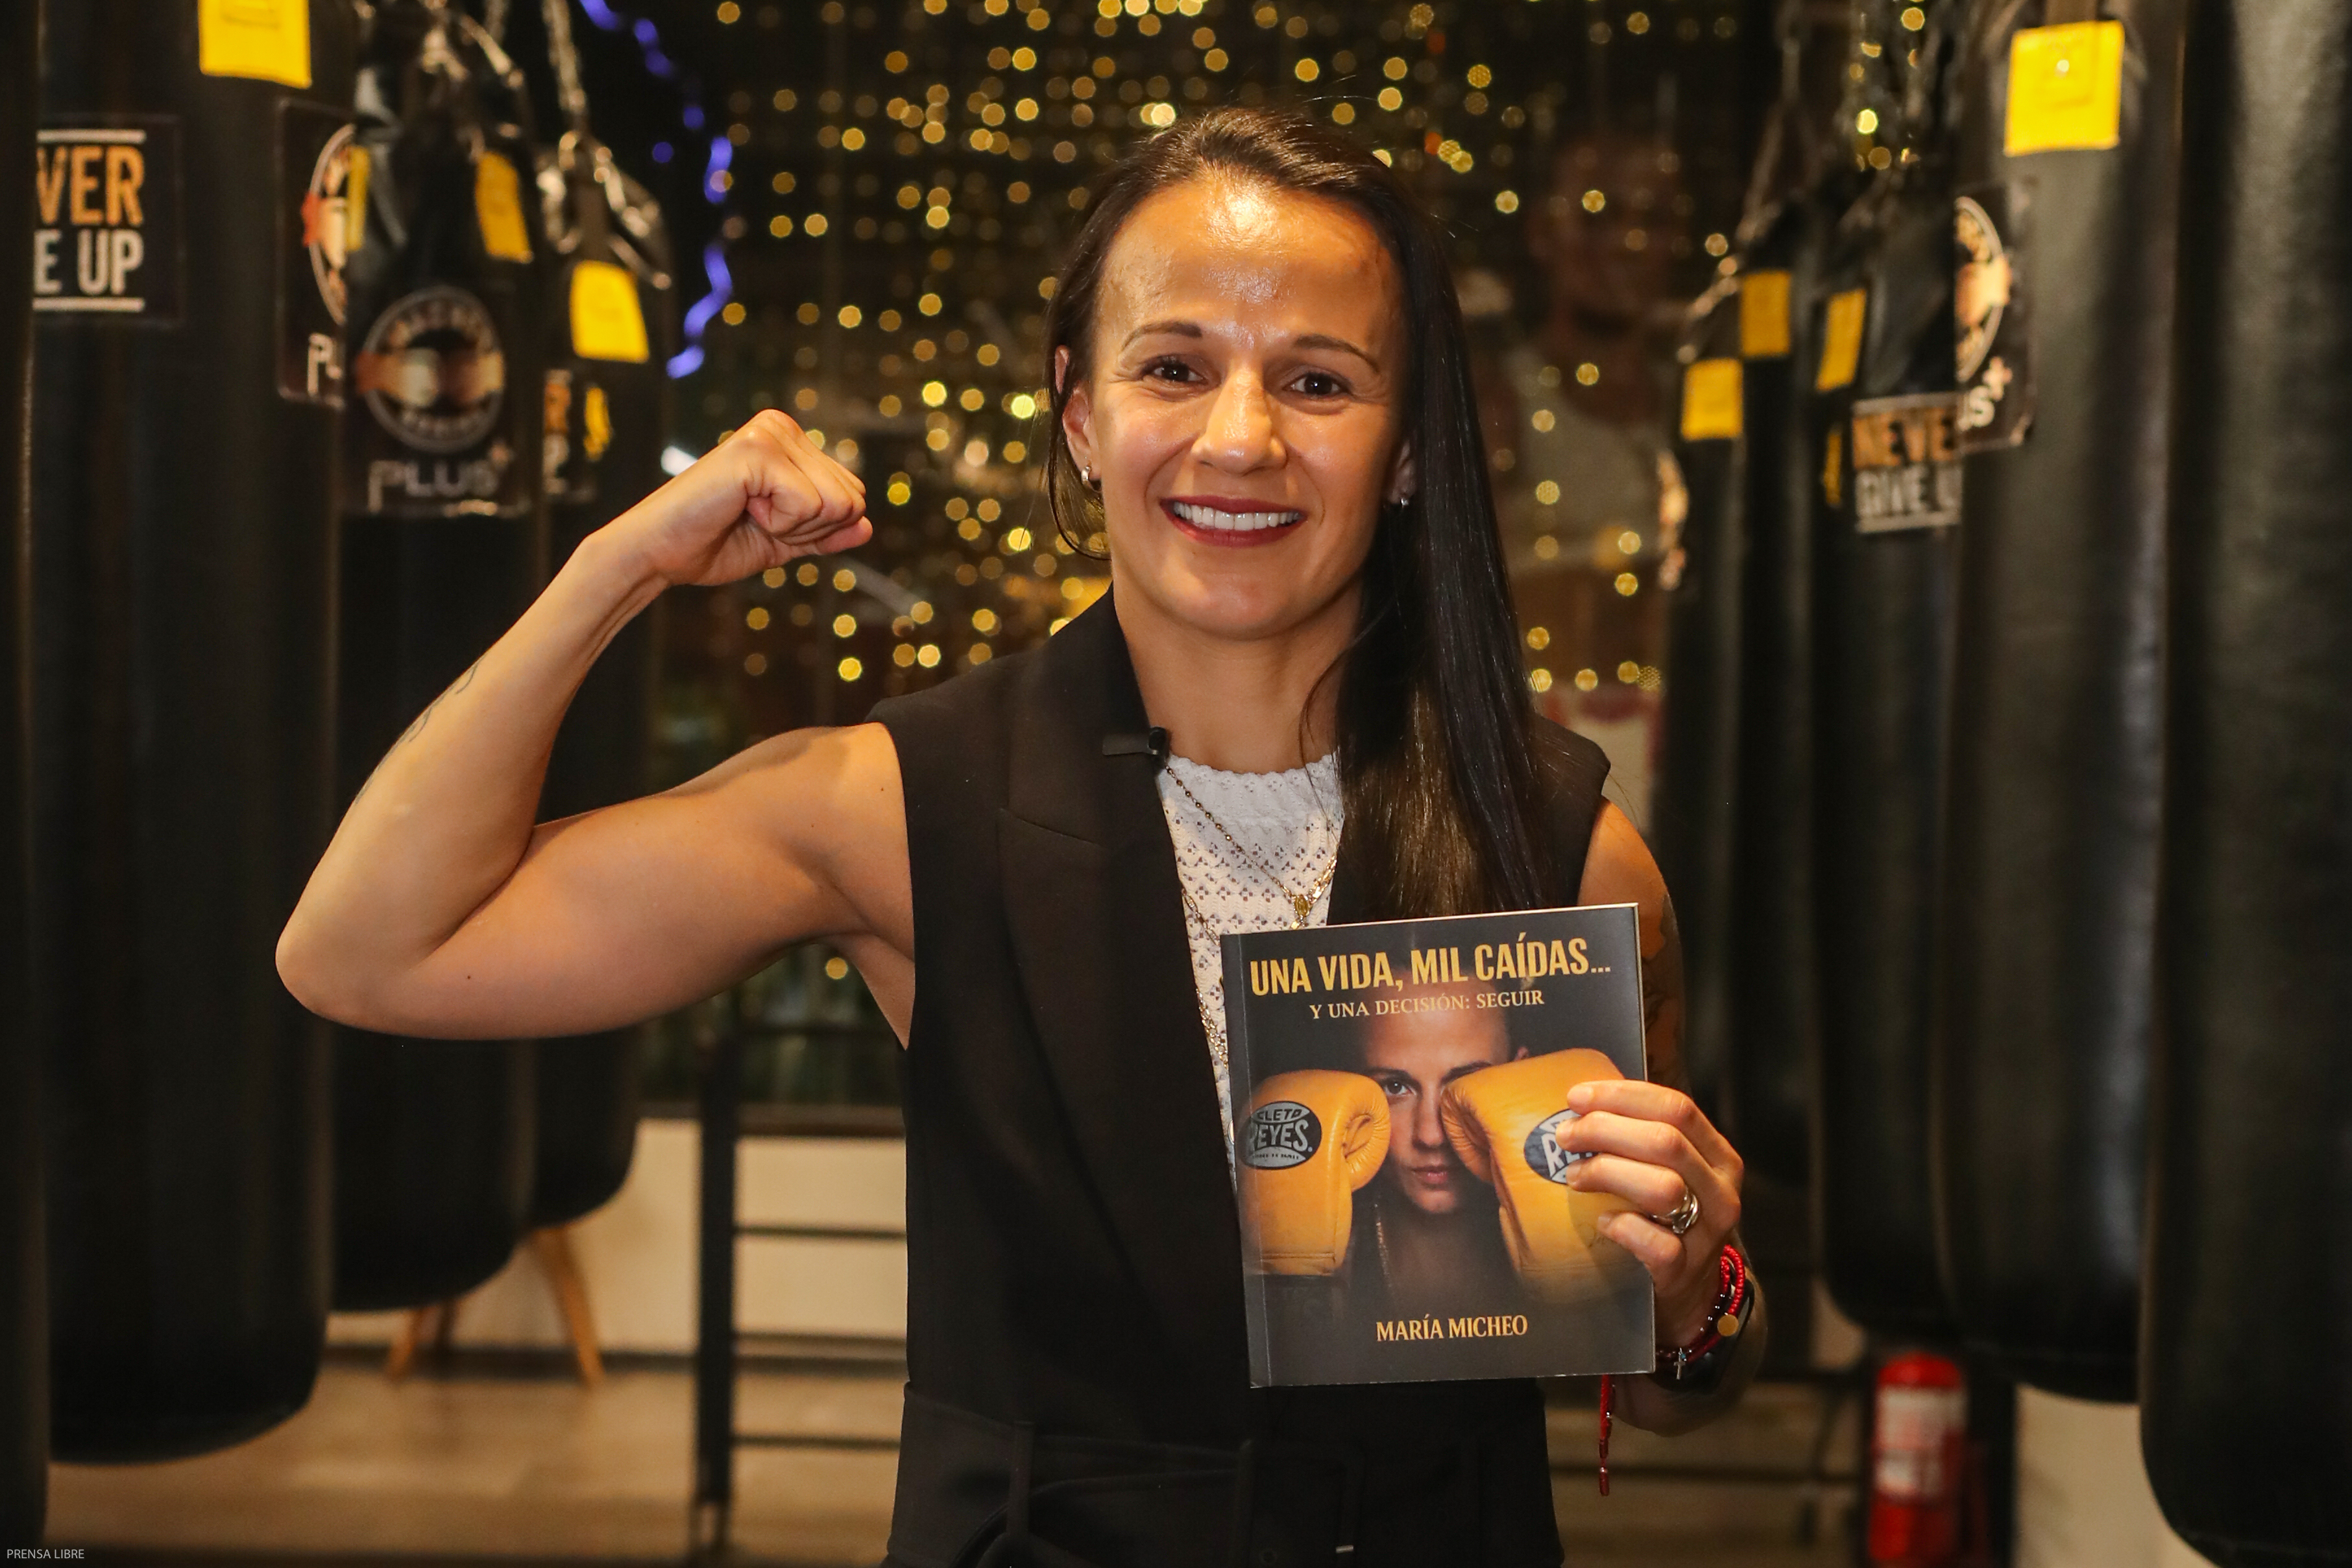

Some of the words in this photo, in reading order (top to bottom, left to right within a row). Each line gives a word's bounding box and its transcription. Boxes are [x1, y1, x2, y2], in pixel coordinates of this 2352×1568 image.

[77, 229, 145, 295] UP
[1250, 958, 1312, 996] UNA
[1318, 951, 1403, 992] VIDA,
[1411, 947, 1468, 985] MIL
[1474, 932, 1611, 981] CAÍDAS...
[1309, 1004, 1322, 1019] Y
[1328, 1002, 1370, 1019] UNA
[1375, 993, 1470, 1016] DECISIÓN:
[1476, 989, 1544, 1009] SEGUIR
[1257, 1108, 1303, 1121] CLETO
[1376, 1314, 1444, 1342] MARÍA
[1448, 1314, 1528, 1339] MICHEO
